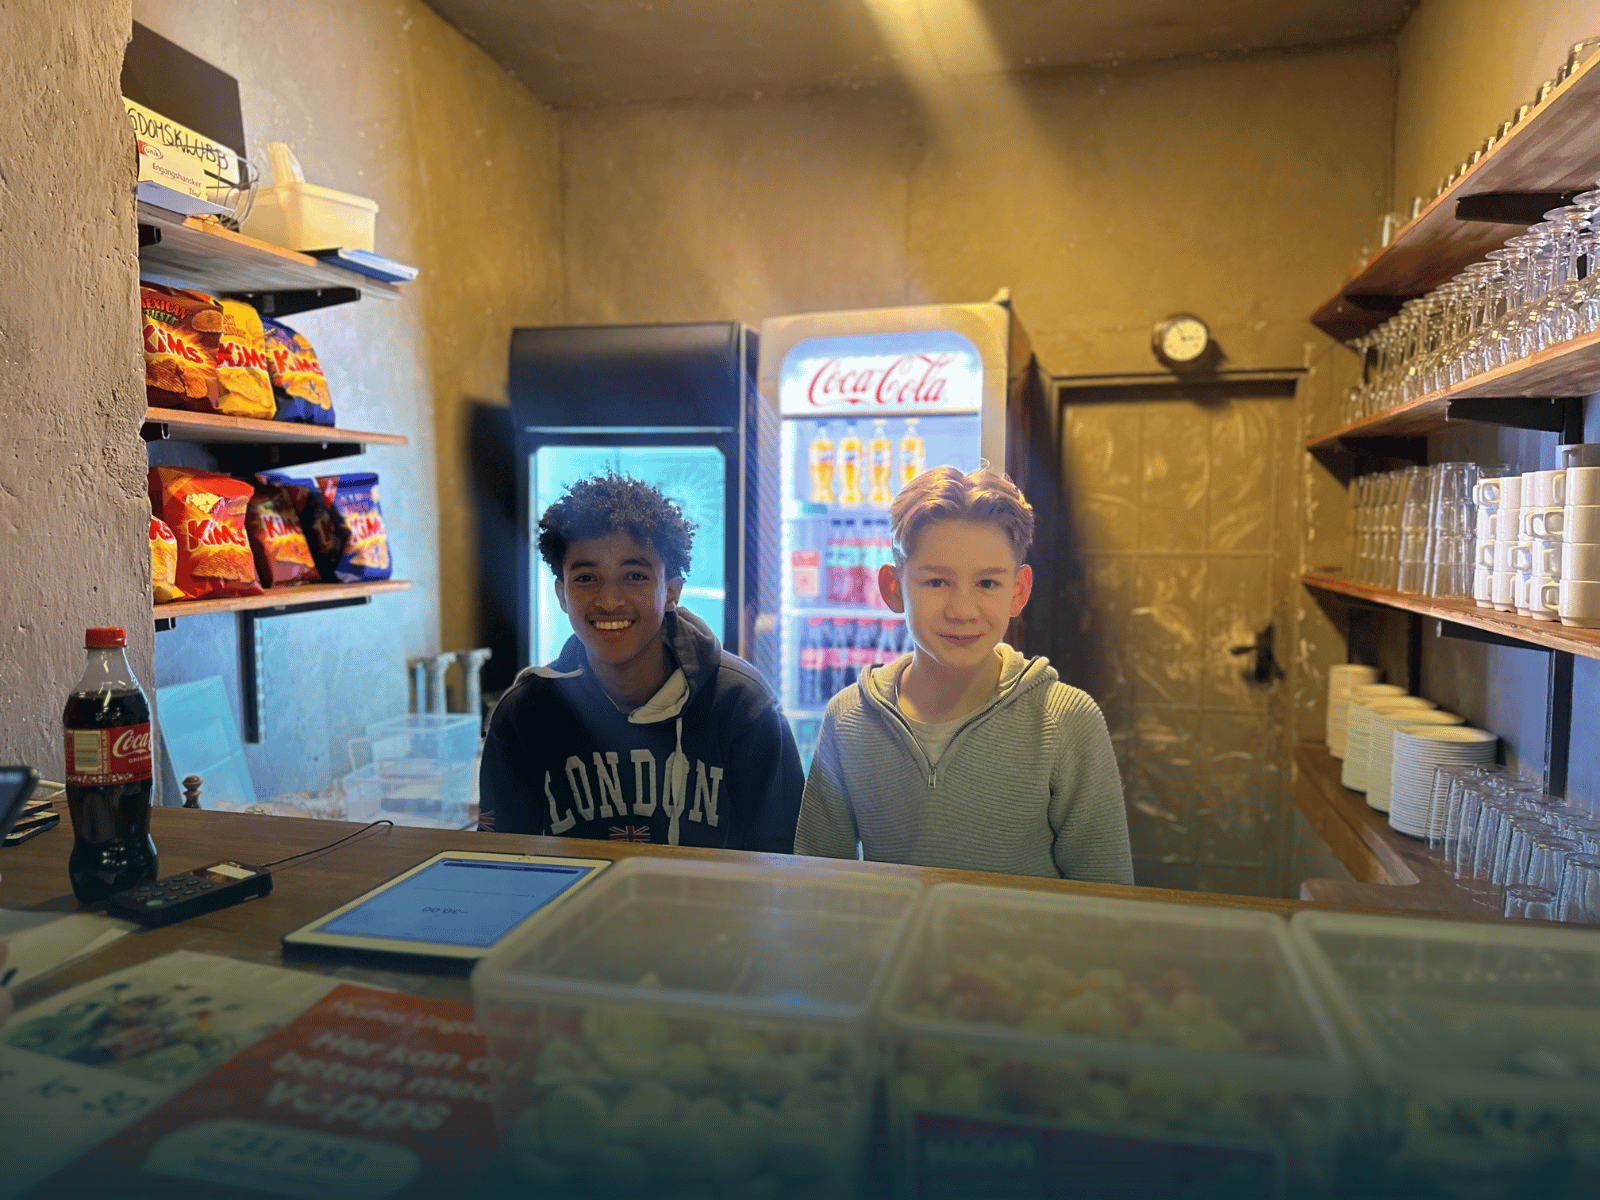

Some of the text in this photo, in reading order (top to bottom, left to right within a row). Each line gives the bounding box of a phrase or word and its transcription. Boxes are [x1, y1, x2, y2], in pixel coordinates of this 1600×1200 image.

[545, 749, 723, 835] LONDON
[271, 1050, 401, 1093] betale
[309, 1031, 384, 1059] Her
[386, 1044, 462, 1070] kan
